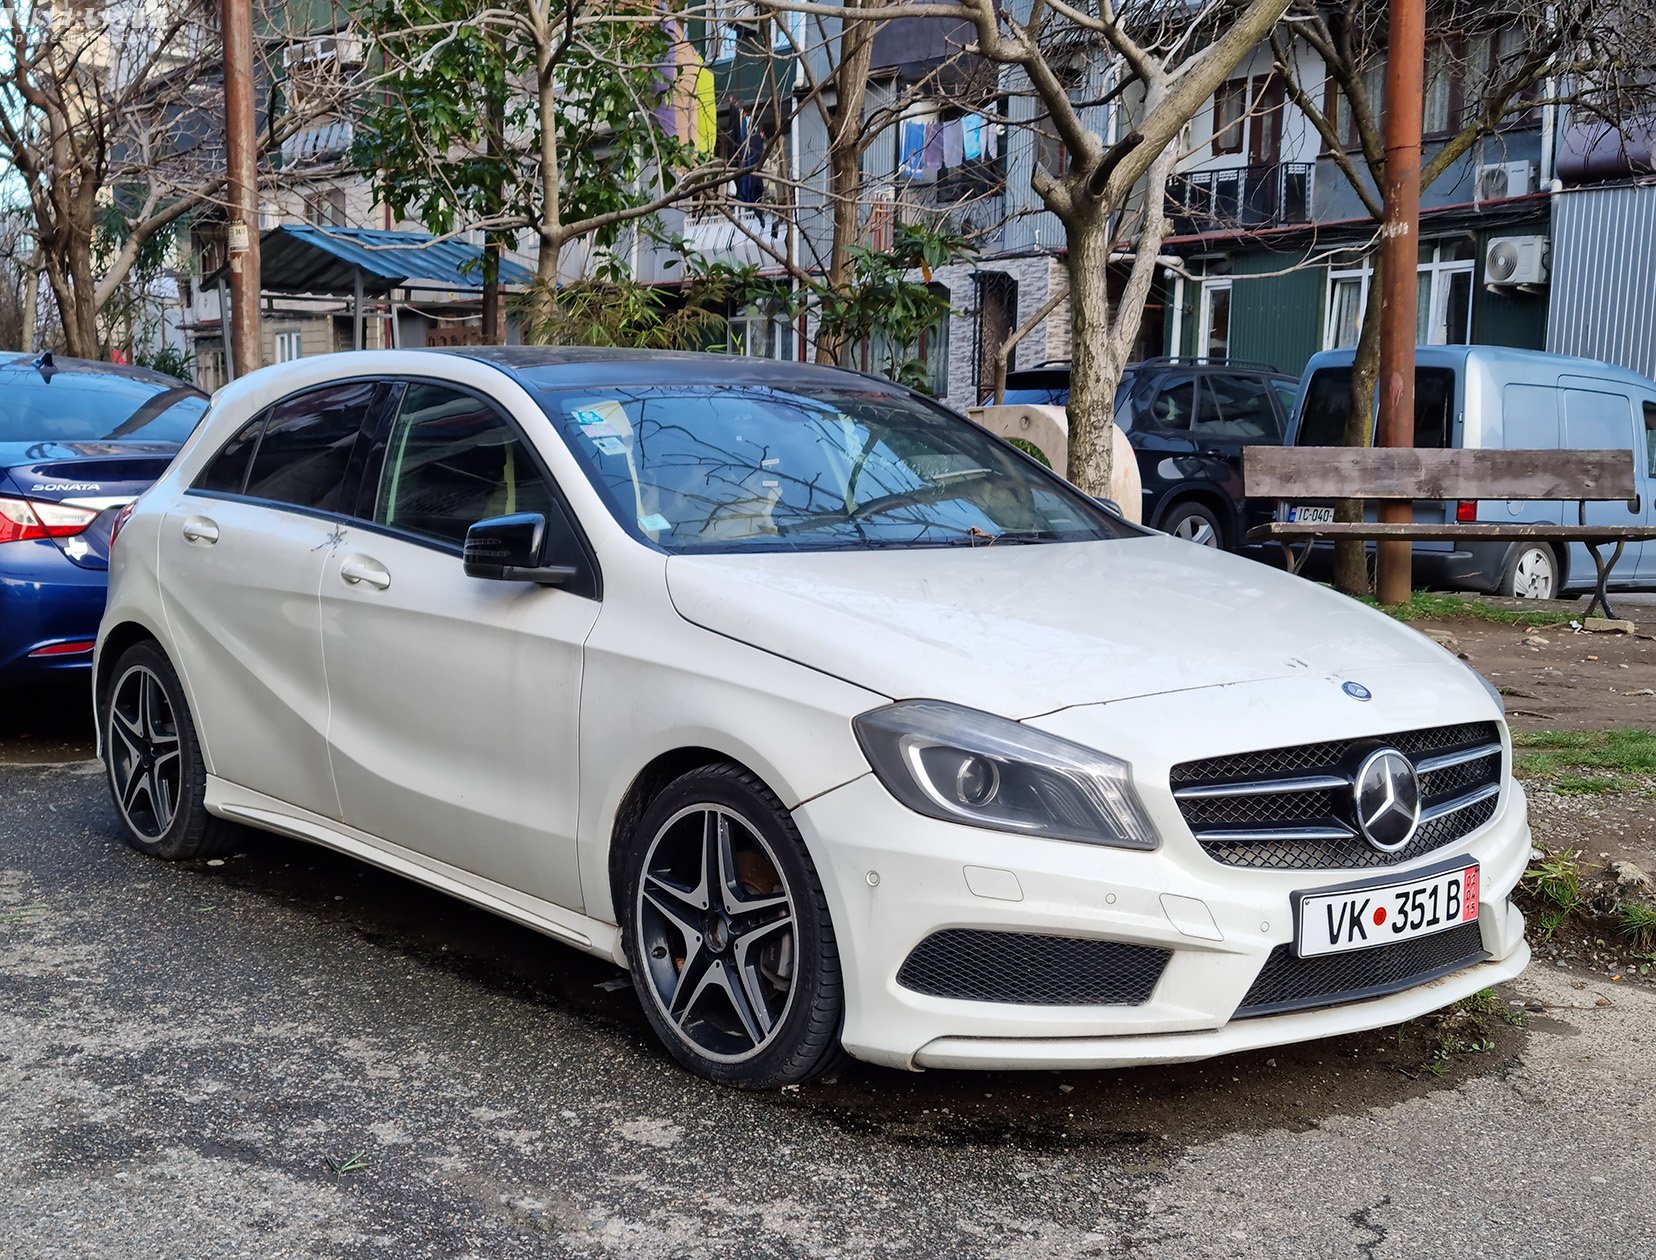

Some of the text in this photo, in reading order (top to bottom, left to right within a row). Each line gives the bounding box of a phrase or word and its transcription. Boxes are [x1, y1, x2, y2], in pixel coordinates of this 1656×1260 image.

[1466, 873, 1476, 887] 02
[1465, 902, 1475, 916] 15
[1326, 898, 1371, 945] VK
